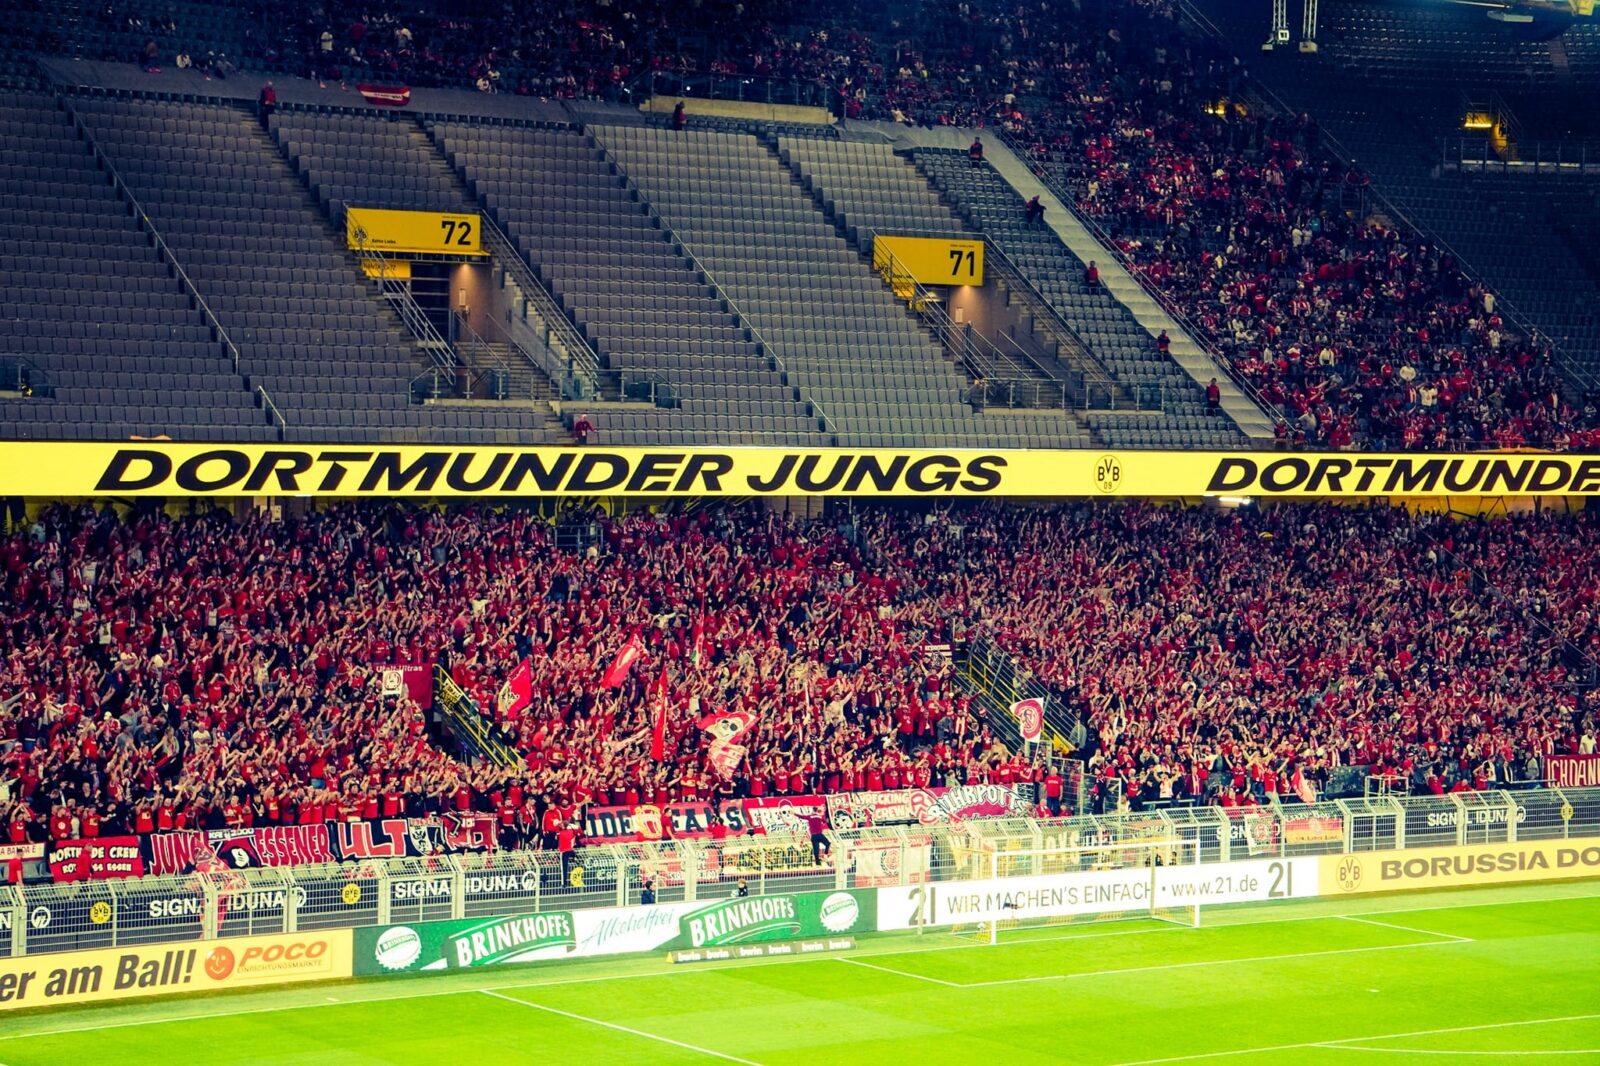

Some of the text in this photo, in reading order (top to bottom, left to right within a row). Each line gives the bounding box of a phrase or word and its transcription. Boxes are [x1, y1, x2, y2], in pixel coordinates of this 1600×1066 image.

[441, 220, 471, 245] 72
[950, 250, 975, 276] 71
[93, 449, 1008, 492] DORTMUNDER JUNGS
[1097, 459, 1120, 482] BVB
[109, 846, 139, 859] CREW
[255, 823, 335, 868] ESSENER
[1340, 859, 1360, 881] BVB
[1381, 850, 1550, 881] BORUSSIA
[465, 874, 518, 894] IDUNA
[908, 861, 1292, 926] 21 WIR MACHEN'S EINFACH www.21.de 21
[228, 890, 284, 911] IDUNA
[238, 941, 328, 968] POCO
[707, 950, 729, 959] bwin
[740, 947, 762, 956] bwin
[769, 945, 791, 955] bwin
[802, 942, 823, 951] bwin
[829, 939, 850, 949] bwin
[678, 953, 700, 962] bwin
[44, 964, 103, 997] am
[113, 948, 197, 991] Ball!
